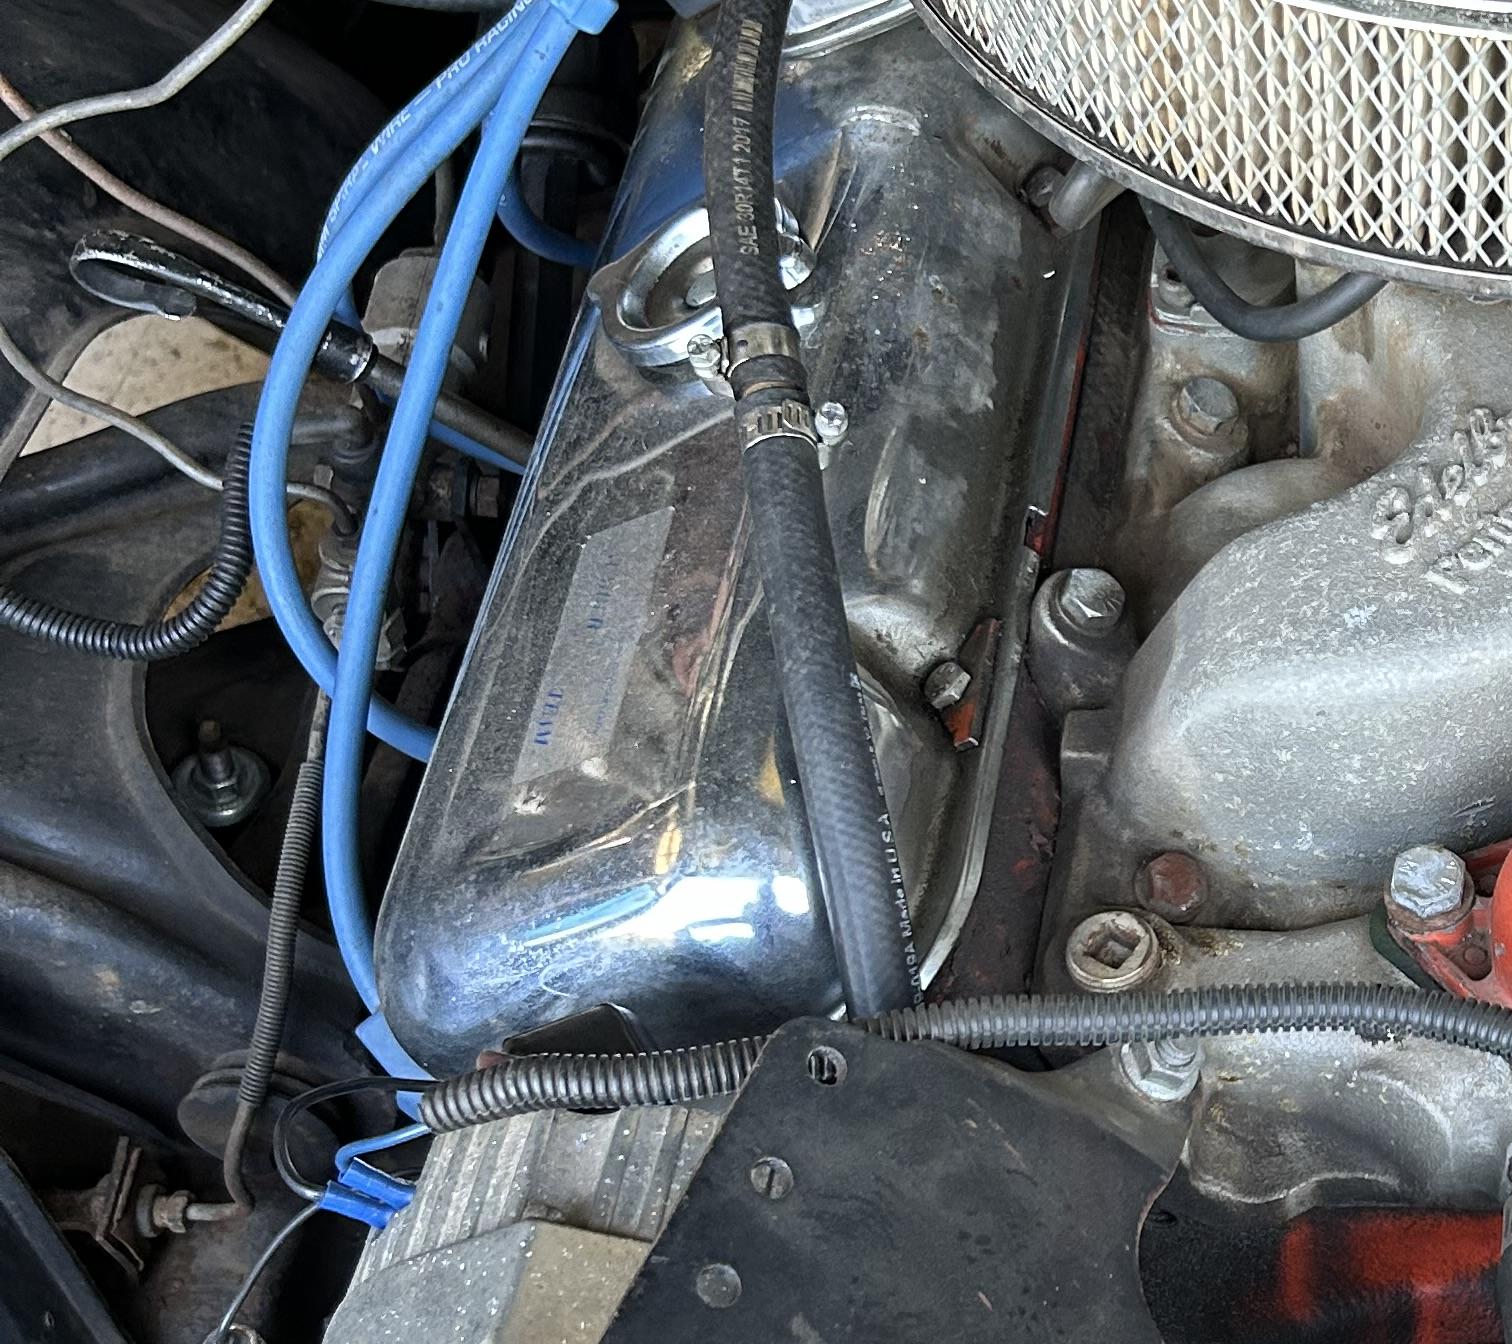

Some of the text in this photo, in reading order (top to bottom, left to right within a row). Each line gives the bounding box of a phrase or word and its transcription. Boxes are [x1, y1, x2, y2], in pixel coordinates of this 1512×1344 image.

[370, 106, 412, 156] WIRE
[435, 52, 472, 89] PRO
[733, 116, 752, 153] 2017
[737, 225, 760, 256] SAE
